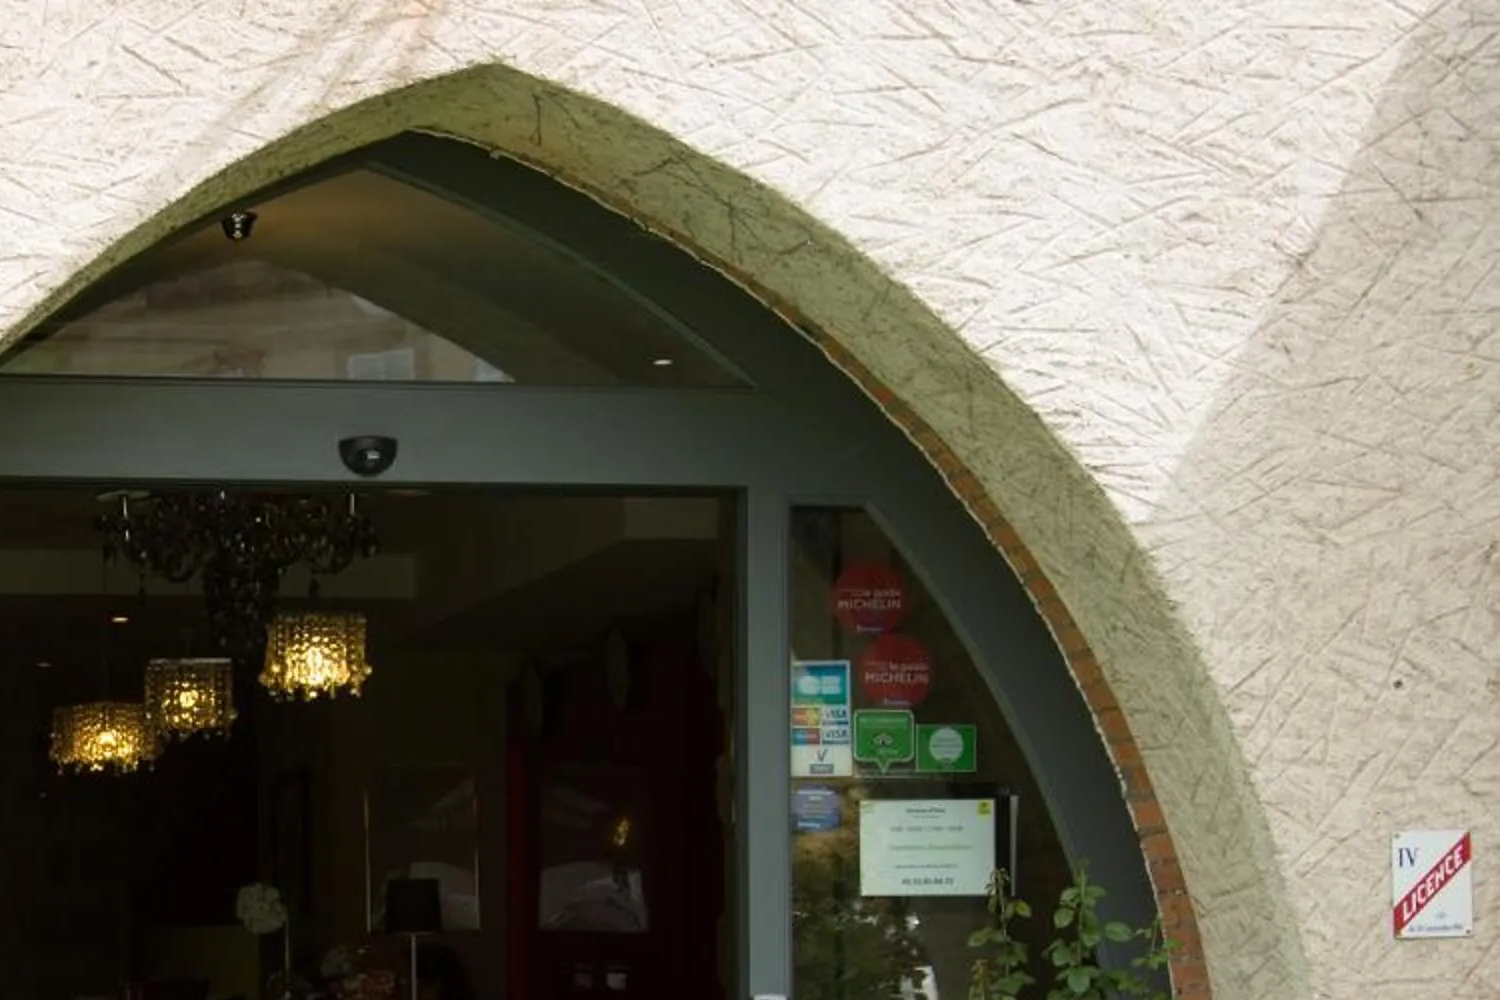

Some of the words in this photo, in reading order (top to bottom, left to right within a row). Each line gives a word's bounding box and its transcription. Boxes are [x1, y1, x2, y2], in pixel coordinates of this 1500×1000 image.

[837, 599, 902, 610] MICHELIN
[864, 671, 930, 684] MICHELIN
[1398, 847, 1419, 868] IV
[1403, 845, 1463, 922] LICENCE
